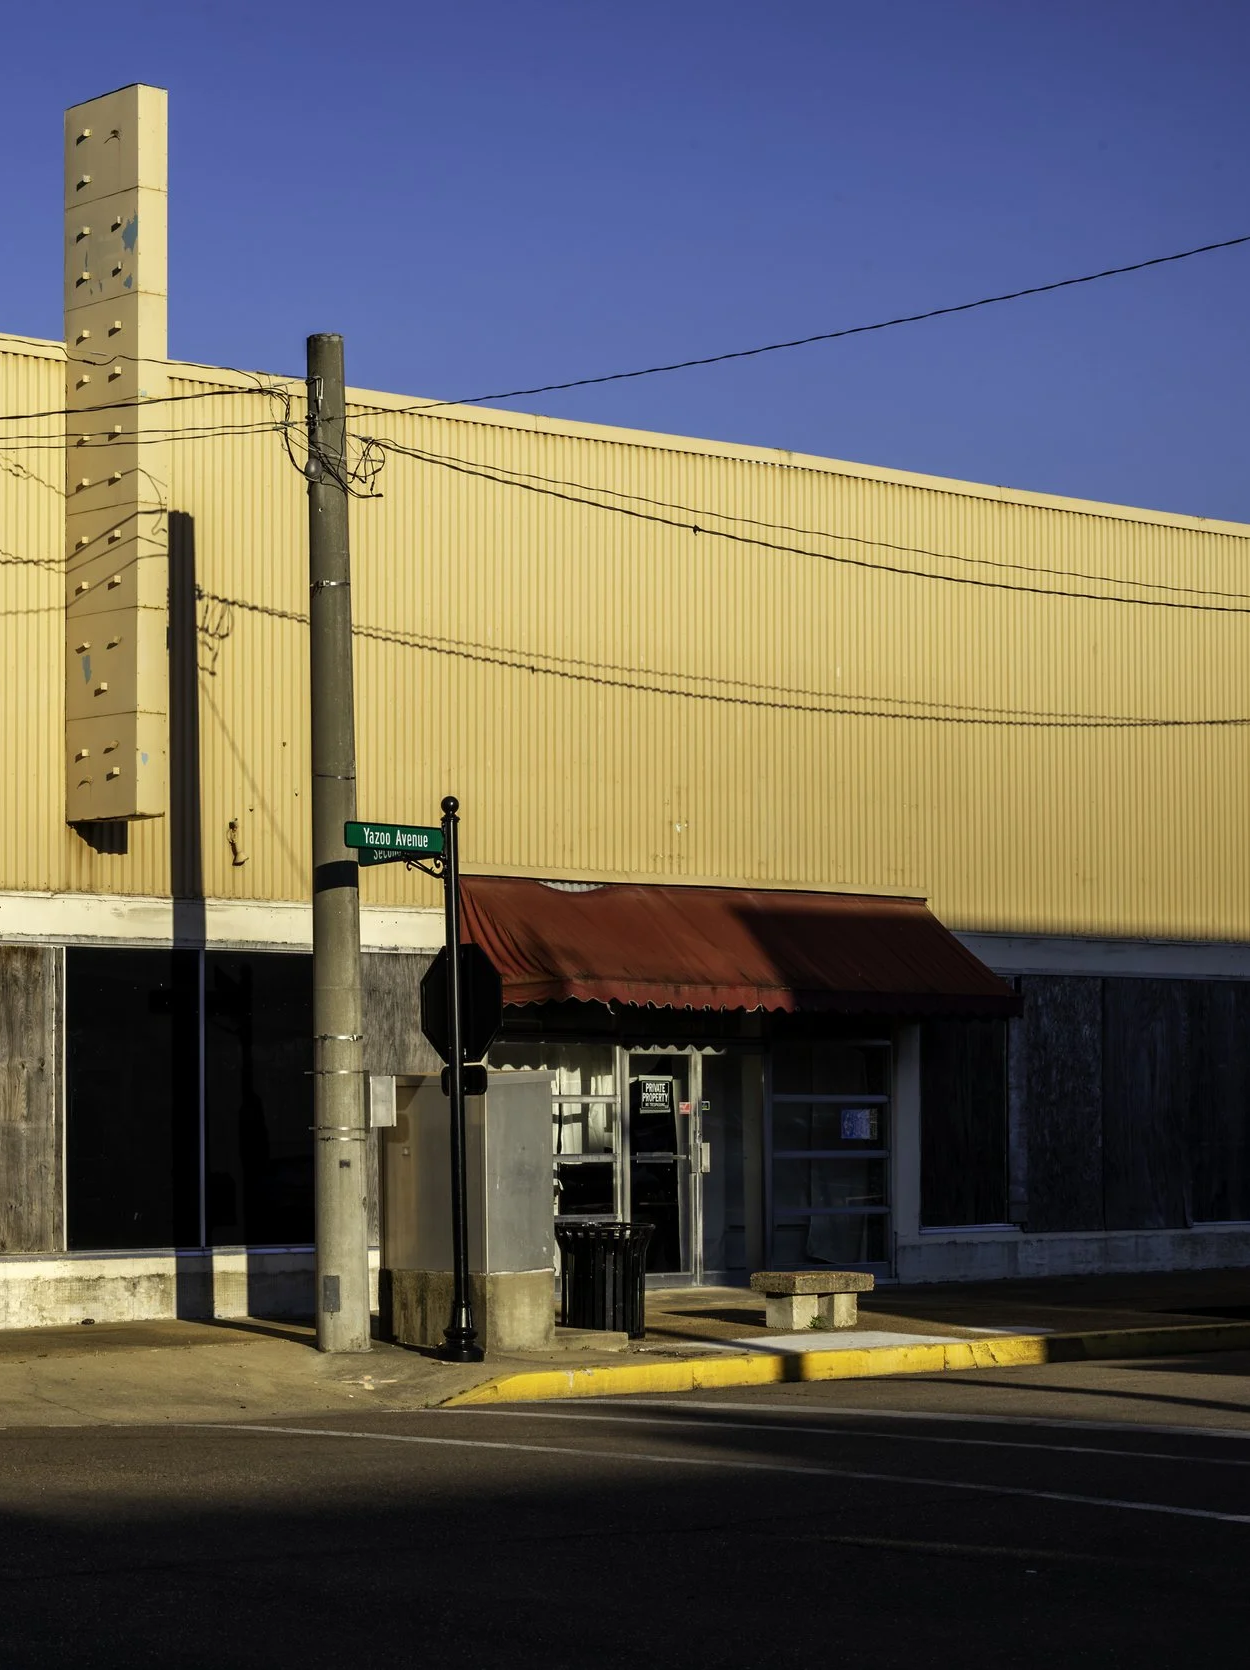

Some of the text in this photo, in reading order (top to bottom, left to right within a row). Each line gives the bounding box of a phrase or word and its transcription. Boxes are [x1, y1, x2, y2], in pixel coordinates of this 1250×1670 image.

[363, 827, 429, 848] Yazoo Avenue
[645, 1083, 666, 1093] PRIVATE
[642, 1093, 669, 1102] PROPERTY
